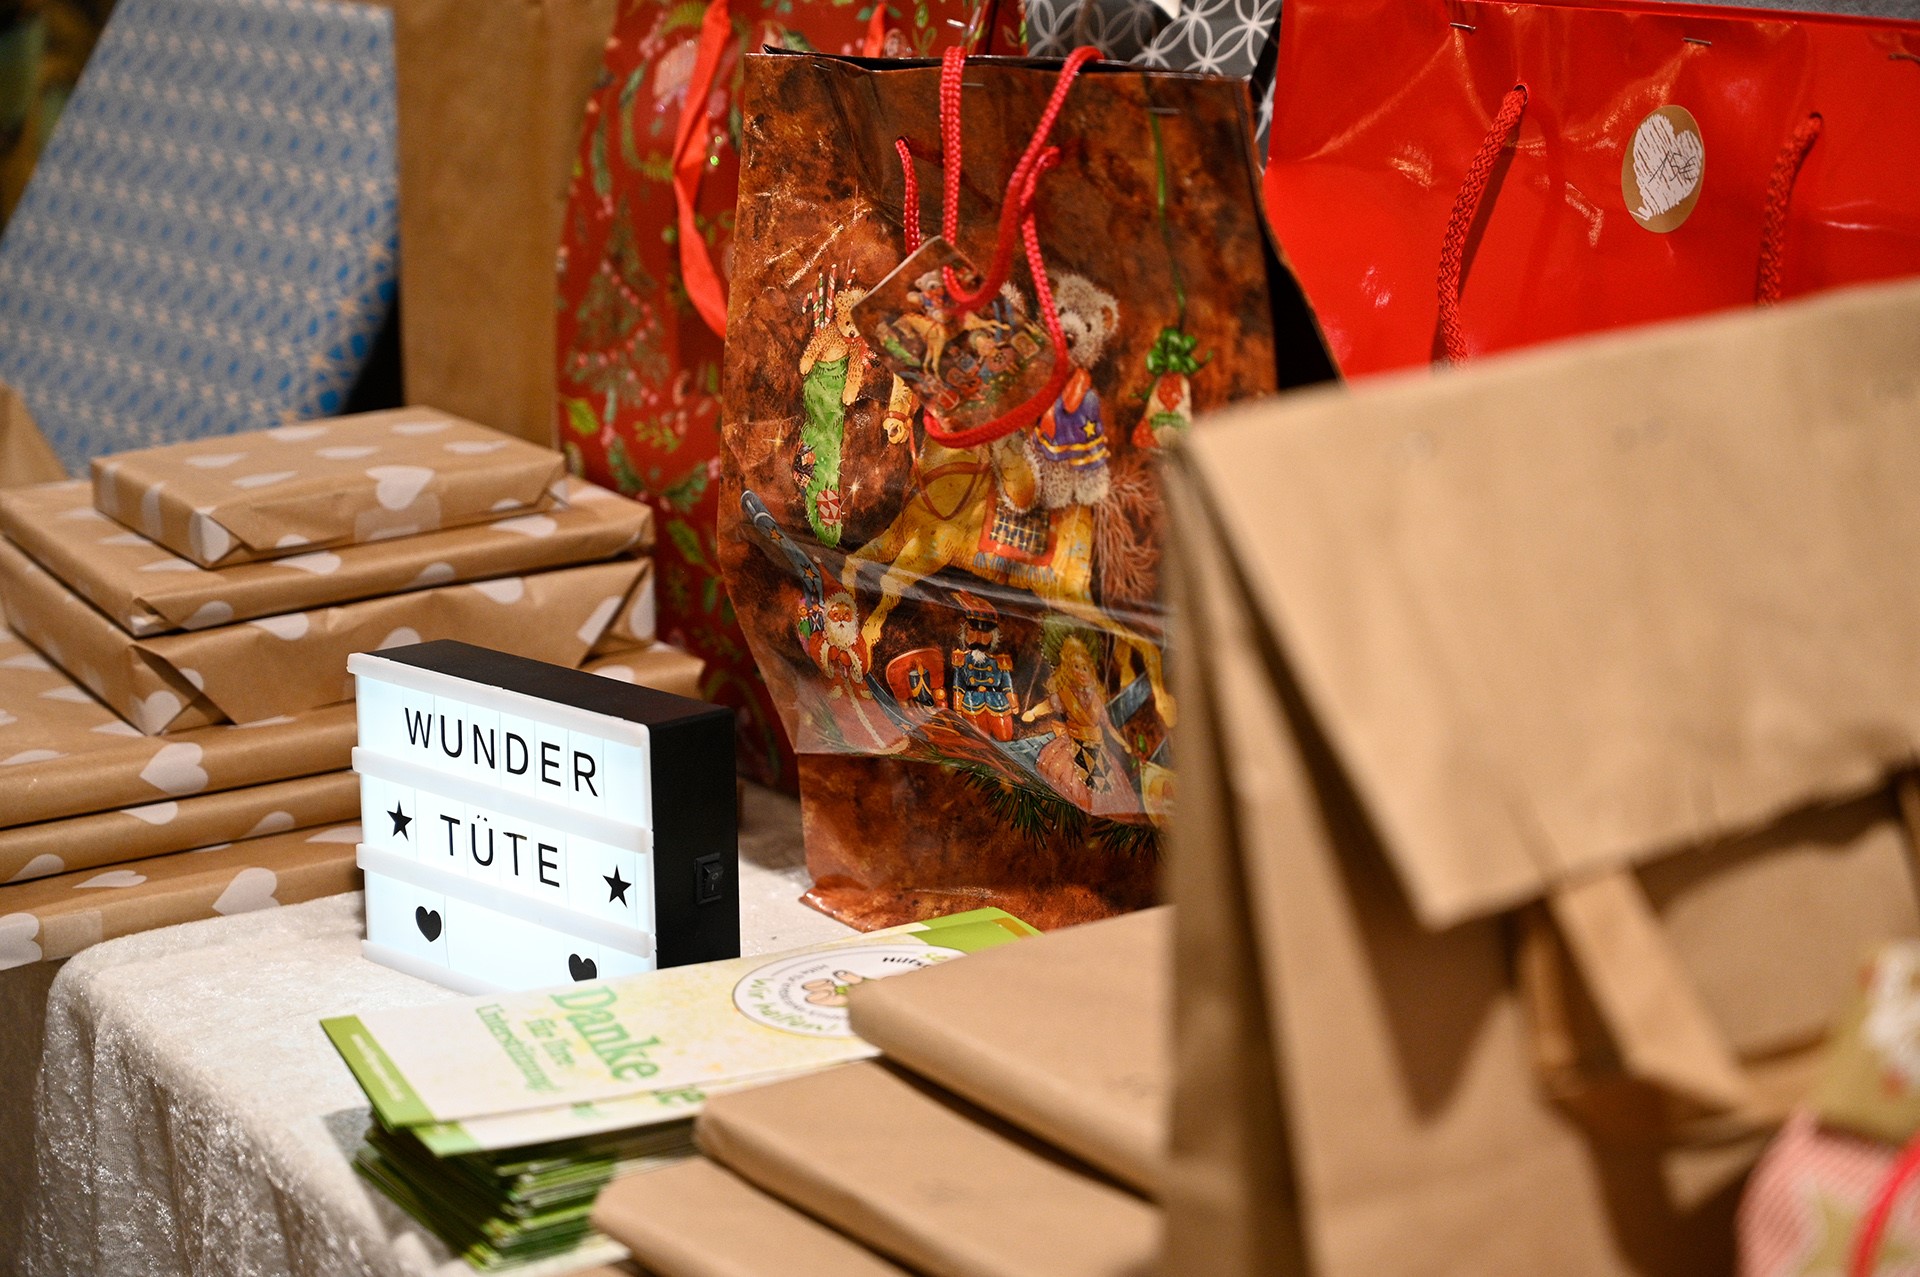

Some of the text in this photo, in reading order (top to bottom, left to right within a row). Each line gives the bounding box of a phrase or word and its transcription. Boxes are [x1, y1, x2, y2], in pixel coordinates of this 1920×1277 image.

[404, 707, 599, 797] WUNDER
[440, 813, 561, 888] TÜTE
[549, 985, 661, 1081] Danke
